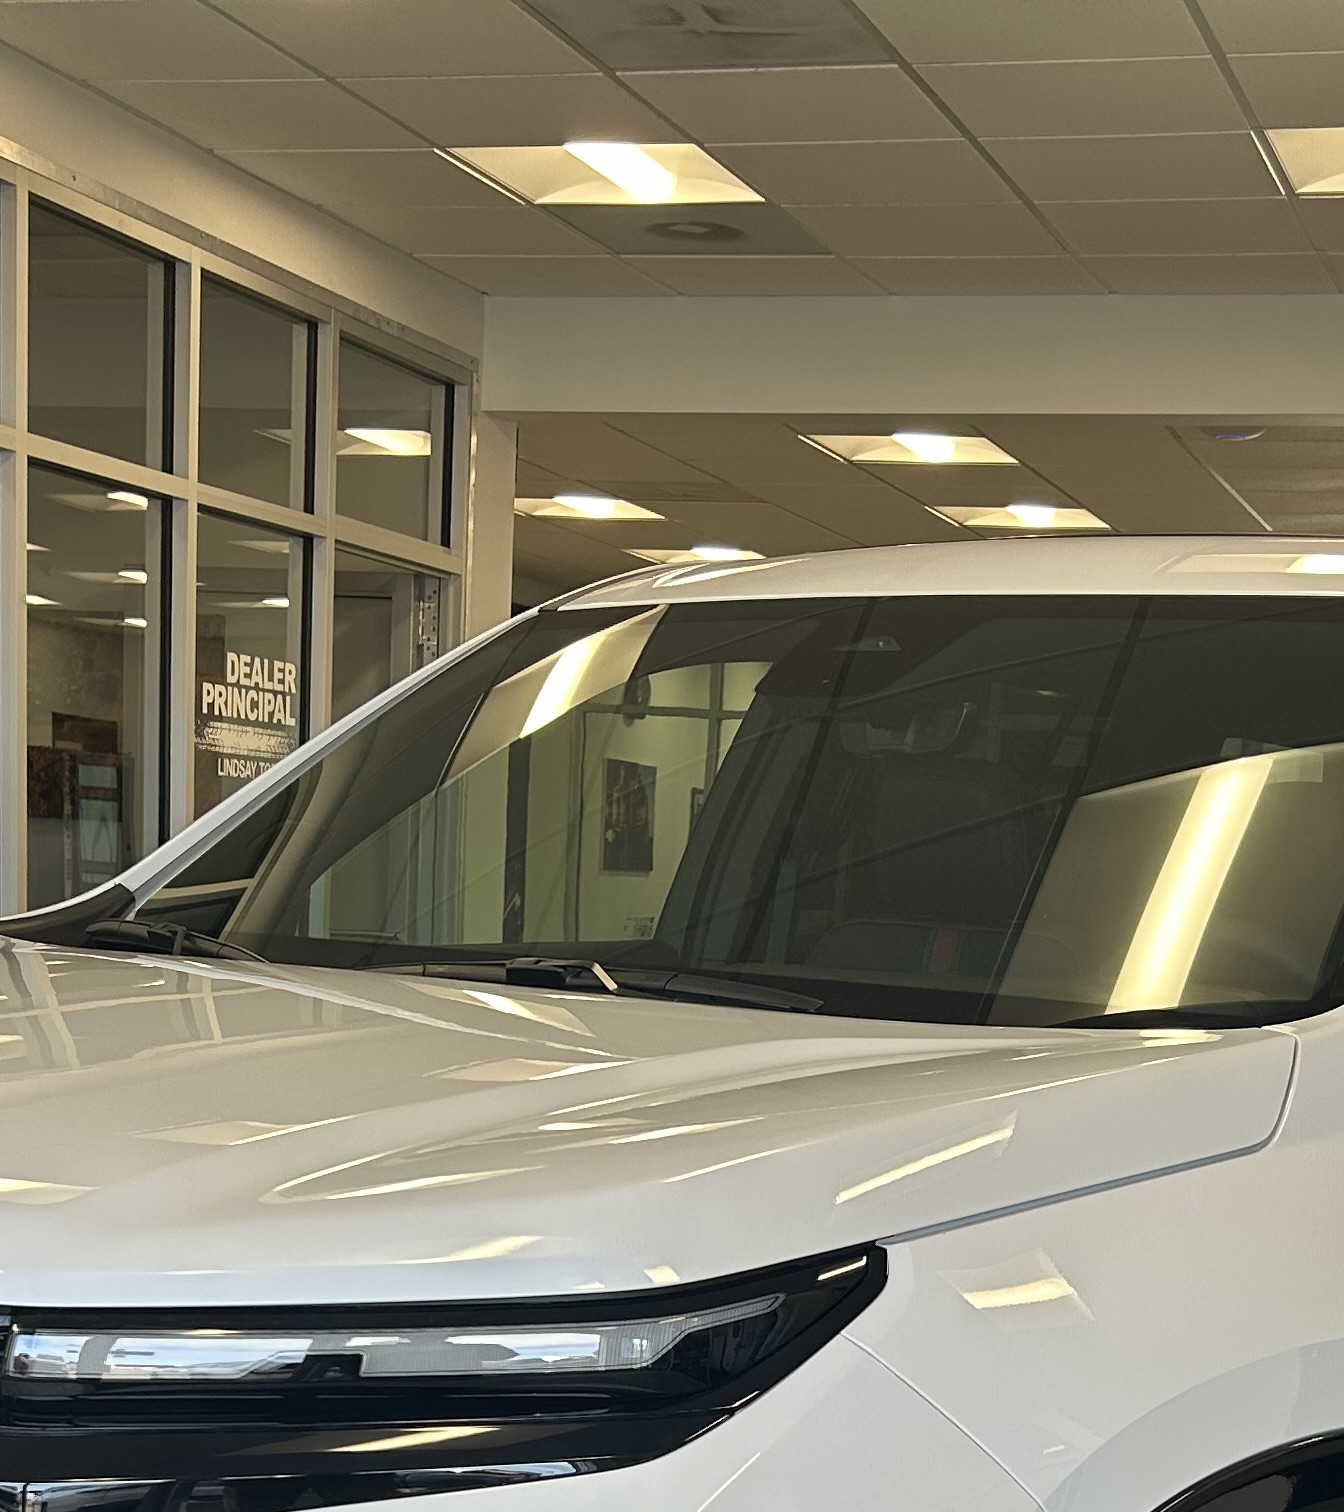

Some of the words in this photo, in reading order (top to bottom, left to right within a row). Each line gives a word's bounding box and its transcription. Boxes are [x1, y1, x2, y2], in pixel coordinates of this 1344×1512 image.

[226, 651, 297, 694] DEALER
[202, 681, 296, 727] PRINCIPAL
[217, 757, 258, 779] LINDSAY
